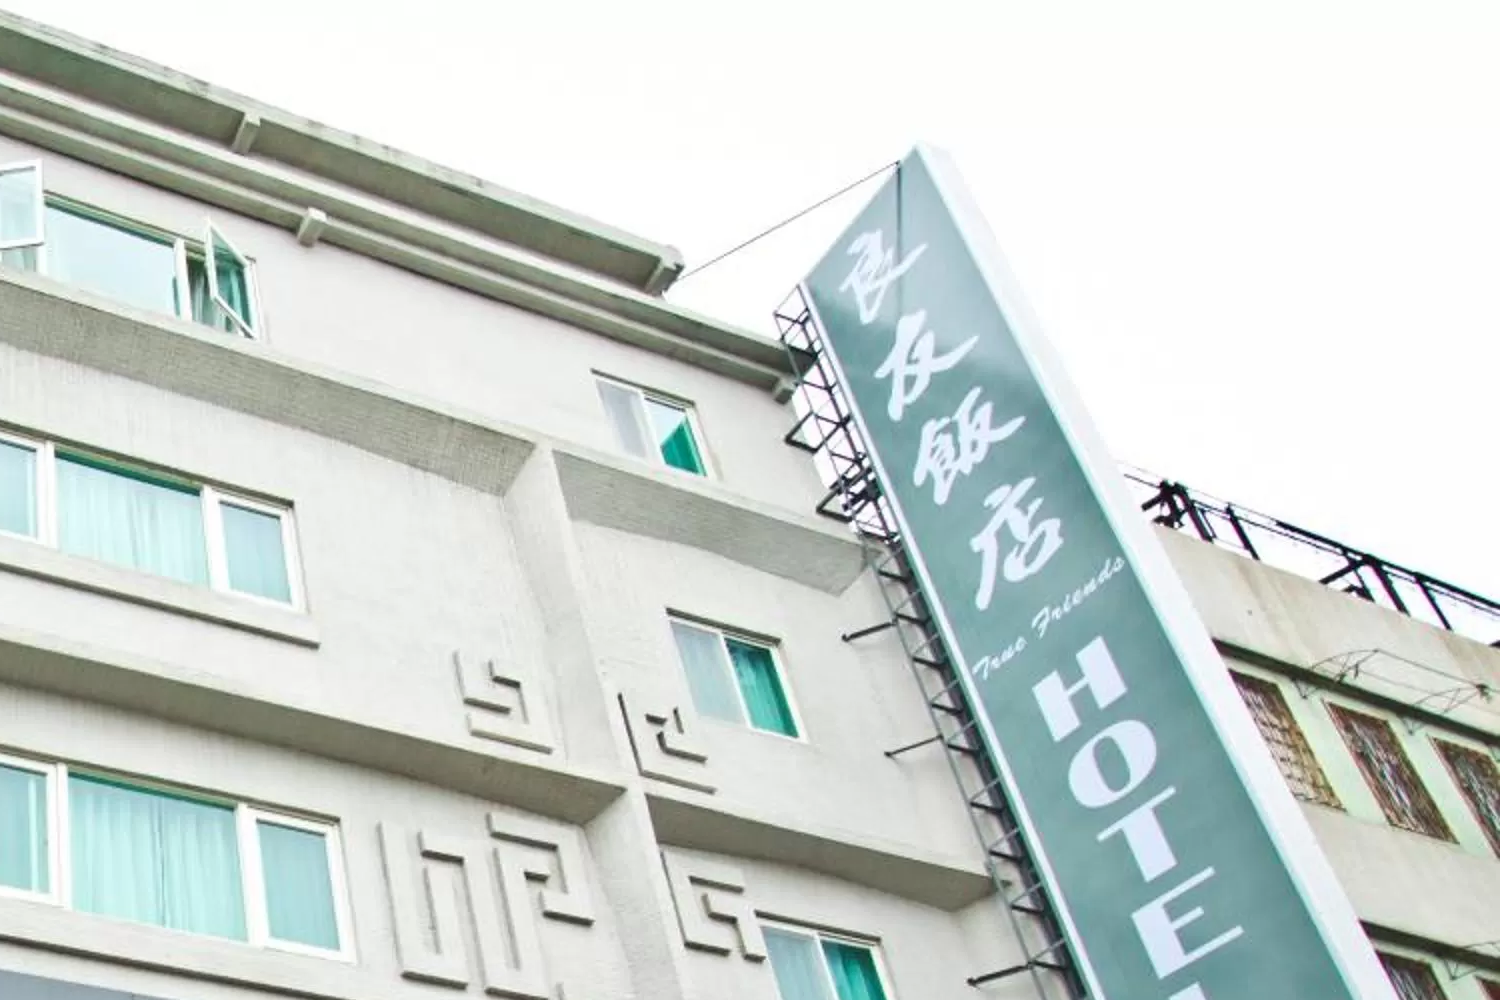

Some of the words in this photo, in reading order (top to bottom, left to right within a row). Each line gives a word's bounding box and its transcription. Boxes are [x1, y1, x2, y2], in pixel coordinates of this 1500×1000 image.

[839, 228, 1064, 612] 良友飯店
[971, 636, 1028, 681] True
[1031, 556, 1126, 640] Friends
